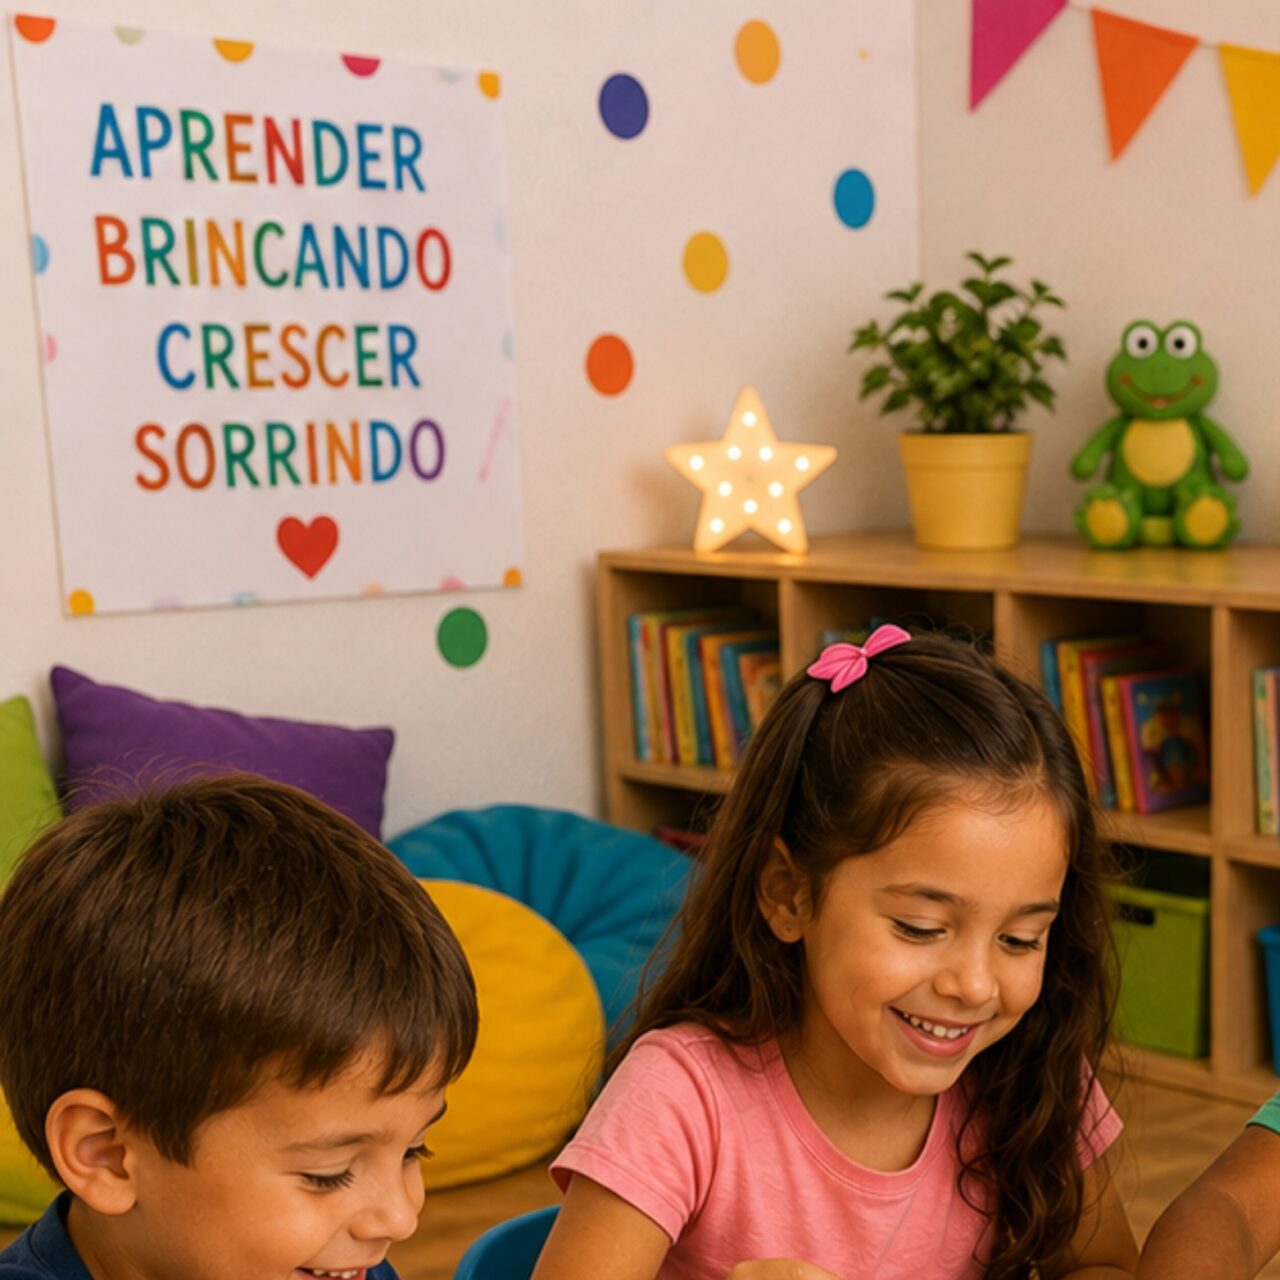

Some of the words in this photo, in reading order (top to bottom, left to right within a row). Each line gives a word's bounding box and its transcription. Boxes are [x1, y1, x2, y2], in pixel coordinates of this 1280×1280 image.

[90, 103, 426, 193] APRENDER
[94, 214, 453, 292] BRINCANDO
[156, 322, 421, 391] CRESCER
[133, 418, 446, 493] SORRINDO
